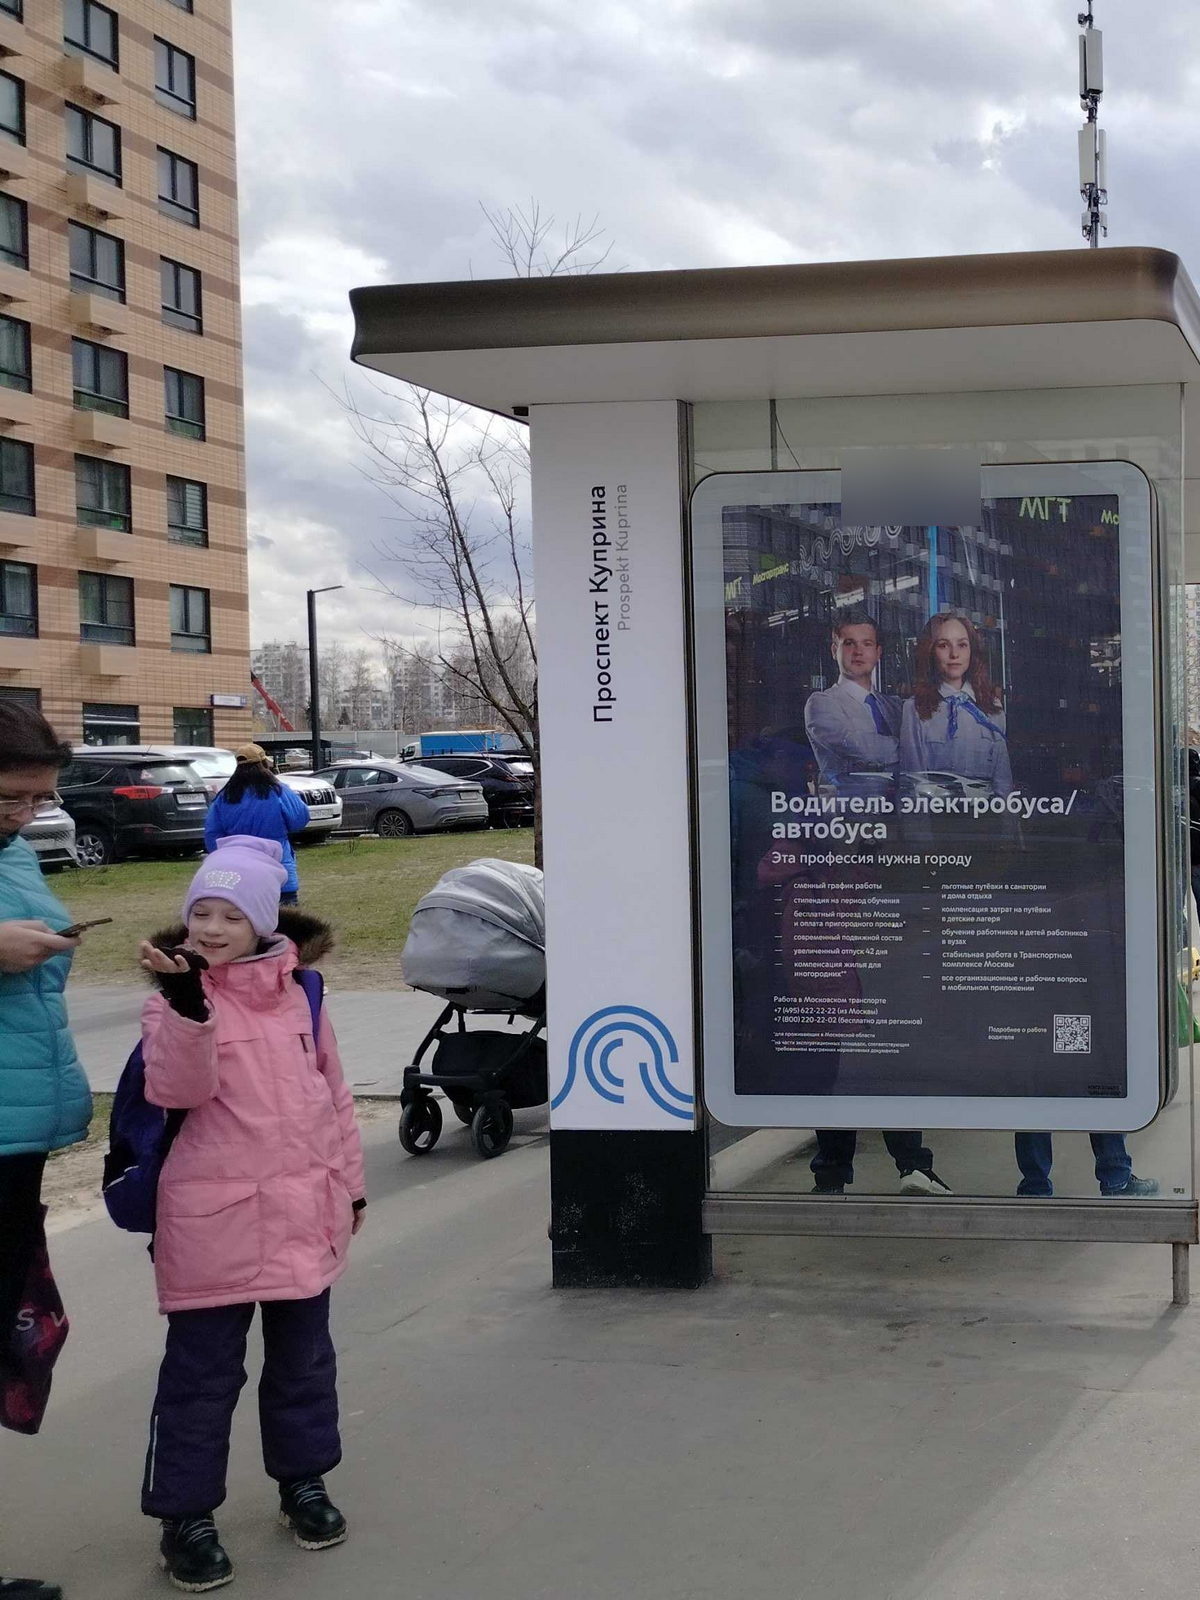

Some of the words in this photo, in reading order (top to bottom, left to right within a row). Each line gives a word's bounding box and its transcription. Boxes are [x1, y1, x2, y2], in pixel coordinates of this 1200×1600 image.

[1019, 497, 1071, 522] МГТ
[613, 484, 631, 551] Kuprina
[589, 485, 613, 593] Куприна
[615, 557, 633, 631] Prospekt
[593, 600, 617, 723] Проспект
[771, 791, 894, 817] Водитель
[900, 789, 1078, 819] электробуса/
[772, 816, 887, 844] автобуса
[772, 851, 796, 864] Эта
[800, 851, 874, 867] профессия
[878, 853, 921, 865] нужна
[924, 853, 972, 867] городу
[794, 882, 826, 890] сменный
[828, 882, 854, 890] график
[855, 882, 882, 890] работы
[975, 883, 1003, 891] путёвки
[867, 897, 900, 905] обучения
[794, 910, 835, 918] бесплатный
[1024, 906, 1052, 914] путёвки
[942, 929, 976, 937] обучение
[976, 929, 1018, 937] работников
[1025, 929, 1045, 937] детей
[1046, 929, 1088, 937] работников
[794, 934, 840, 942] современный
[841, 934, 880, 942] подвижной
[793, 948, 840, 956] увеличенный
[986, 951, 1012, 959] работа
[1019, 951, 1073, 960] Транспортном
[1026, 975, 1056, 983] рабочие
[1057, 976, 1088, 984] вопросы
[804, 996, 847, 1004] Московском
[782, 1007, 800, 1015] (495)
[801, 1007, 836, 1015] 622-22-22
[782, 1016, 800, 1024] (800)
[801, 1016, 837, 1024] 220-22-02
